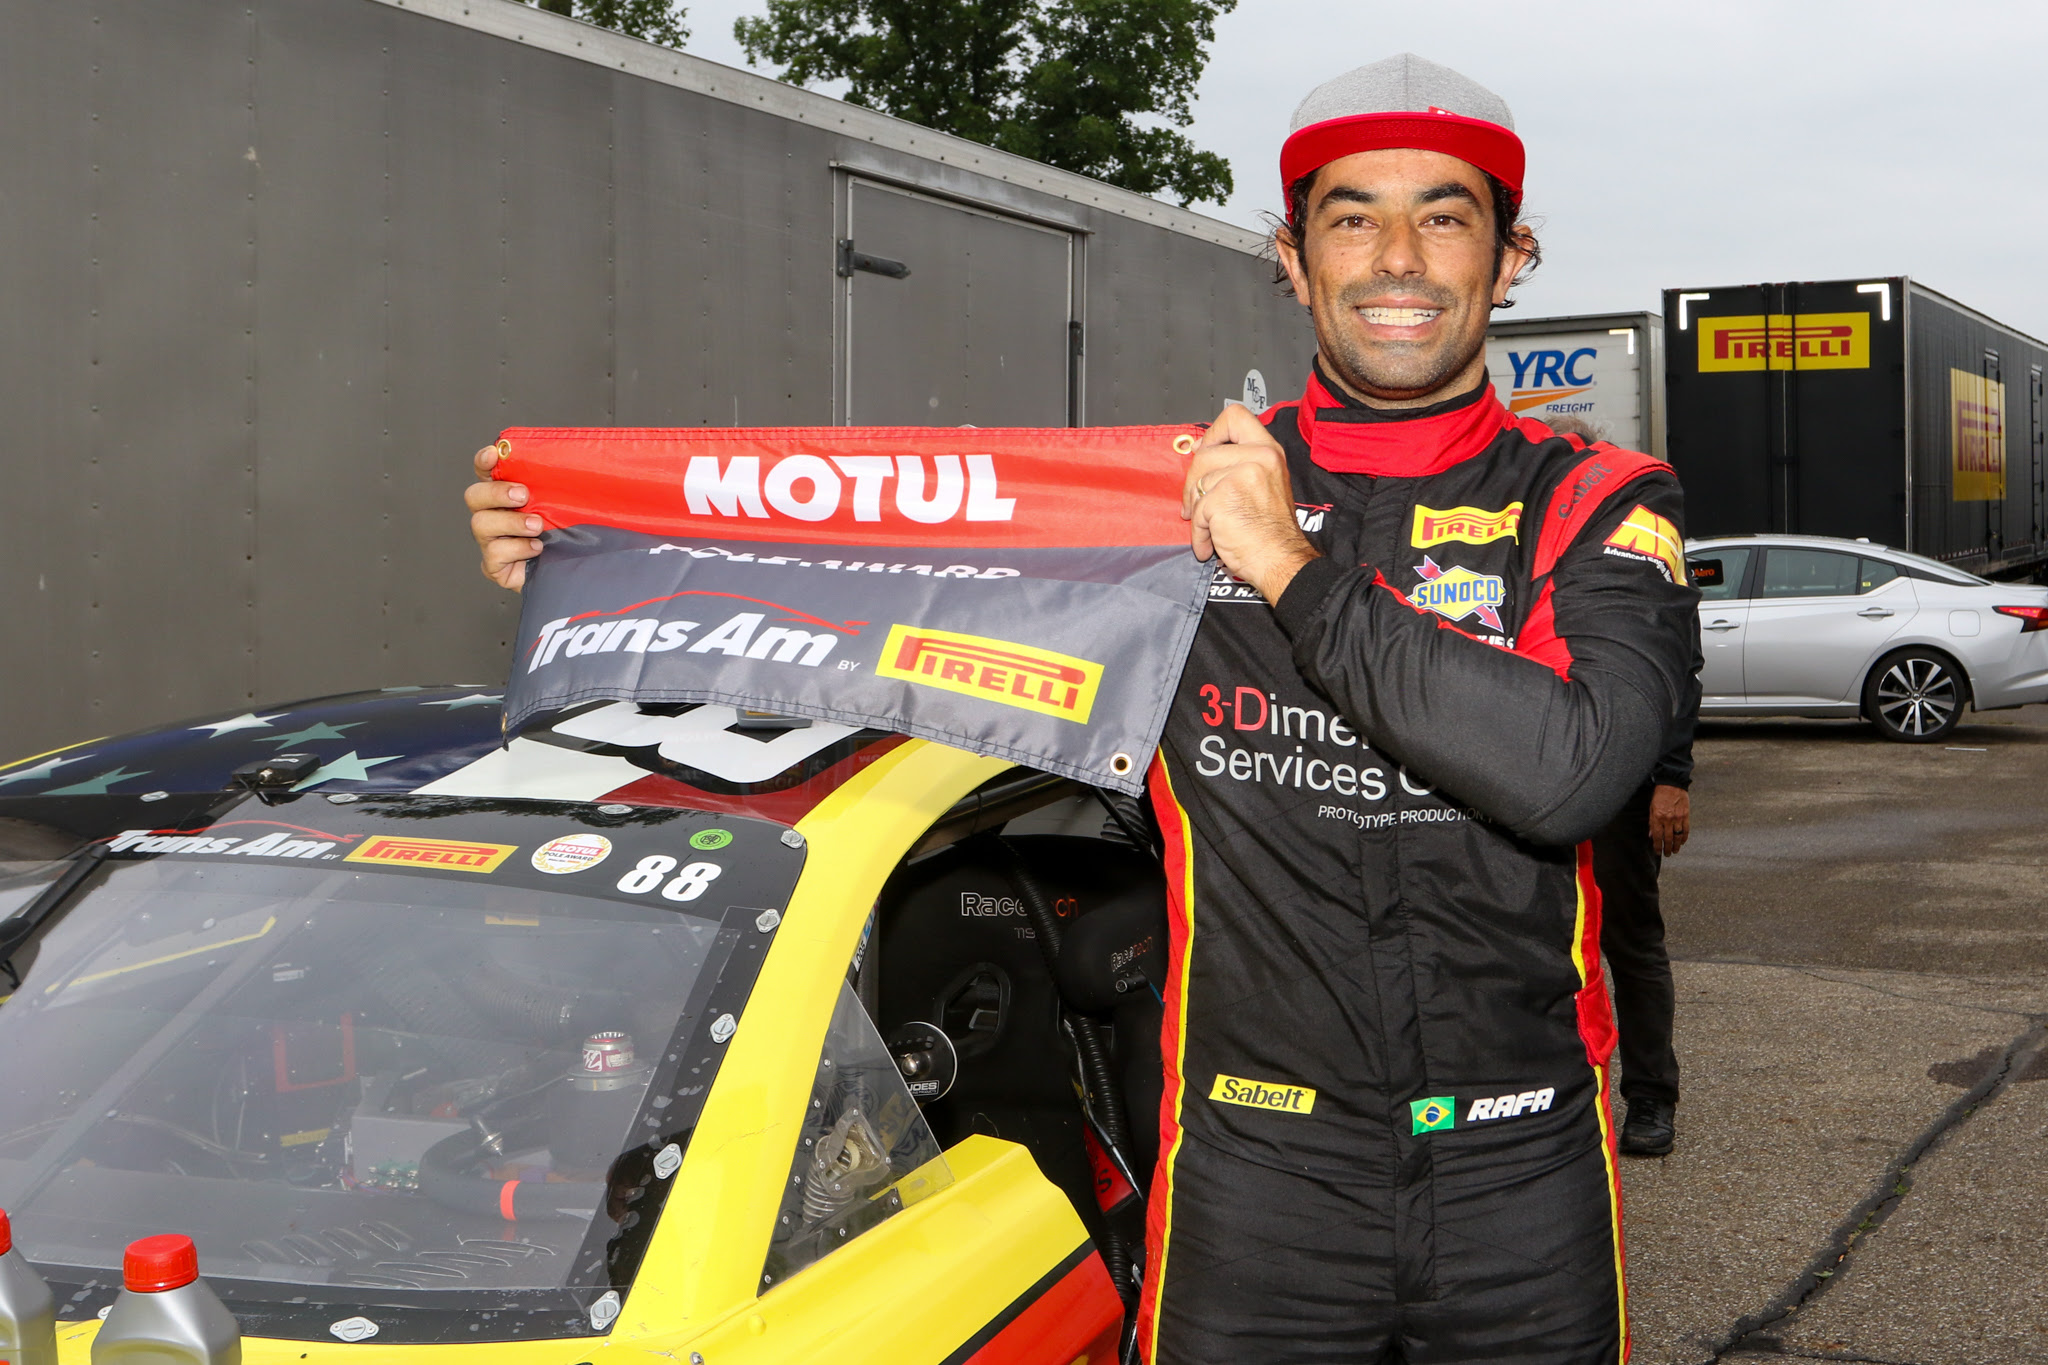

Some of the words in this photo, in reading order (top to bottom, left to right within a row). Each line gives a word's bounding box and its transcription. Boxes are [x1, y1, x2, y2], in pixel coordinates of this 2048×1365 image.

[1714, 326, 1852, 359] PIRELLI
[1508, 348, 1597, 388] YRC
[1546, 403, 1595, 413] FREIGHT
[684, 454, 1016, 522] MOTUL
[1422, 508, 1522, 541] PIRELLI
[1417, 579, 1498, 606] SUNOCO
[528, 616, 700, 675] Trans
[687, 612, 838, 667] Am
[837, 660, 860, 672] BY
[894, 635, 1085, 710] PIRELLI
[1200, 683, 1369, 750] 3-Dime
[1195, 735, 1387, 800] Services
[110, 830, 243, 853] Trans
[223, 832, 336, 859] Am
[364, 840, 499, 866] PIRELLI
[551, 844, 600, 856] MOTUL
[617, 855, 722, 902] 88
[1222, 1078, 1305, 1110] Sabelt
[1467, 1087, 1555, 1122] RAFA
